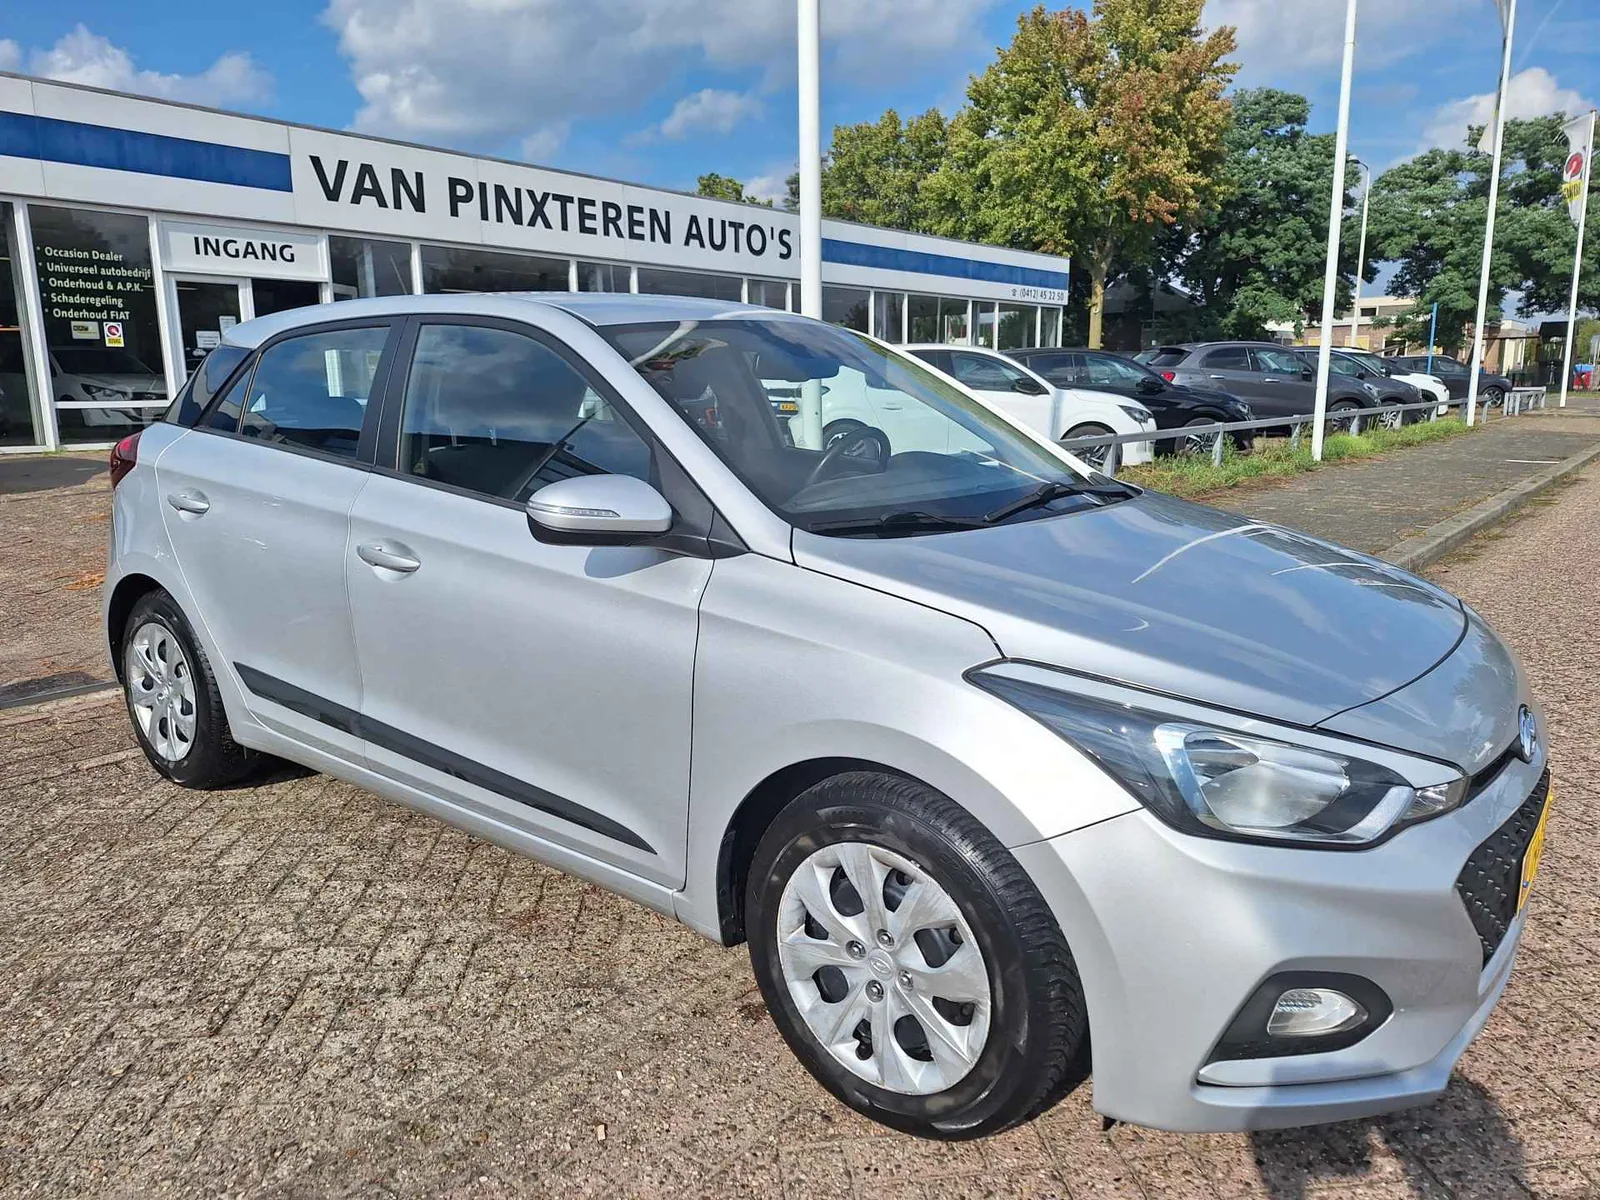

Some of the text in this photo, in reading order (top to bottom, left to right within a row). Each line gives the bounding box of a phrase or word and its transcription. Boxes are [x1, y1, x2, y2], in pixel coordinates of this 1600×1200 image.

[309, 155, 792, 260] VAN PINXTEREN AUTO'S
[45, 246, 123, 261] Occasion Dealer
[194, 236, 295, 263] INGANG
[46, 262, 151, 280] Universeel autobedrijf
[48, 277, 144, 292] Onderhoud & A.P.K.
[50, 293, 123, 308] Schaderegeling
[53, 308, 130, 320] Onderhoud FIAT
